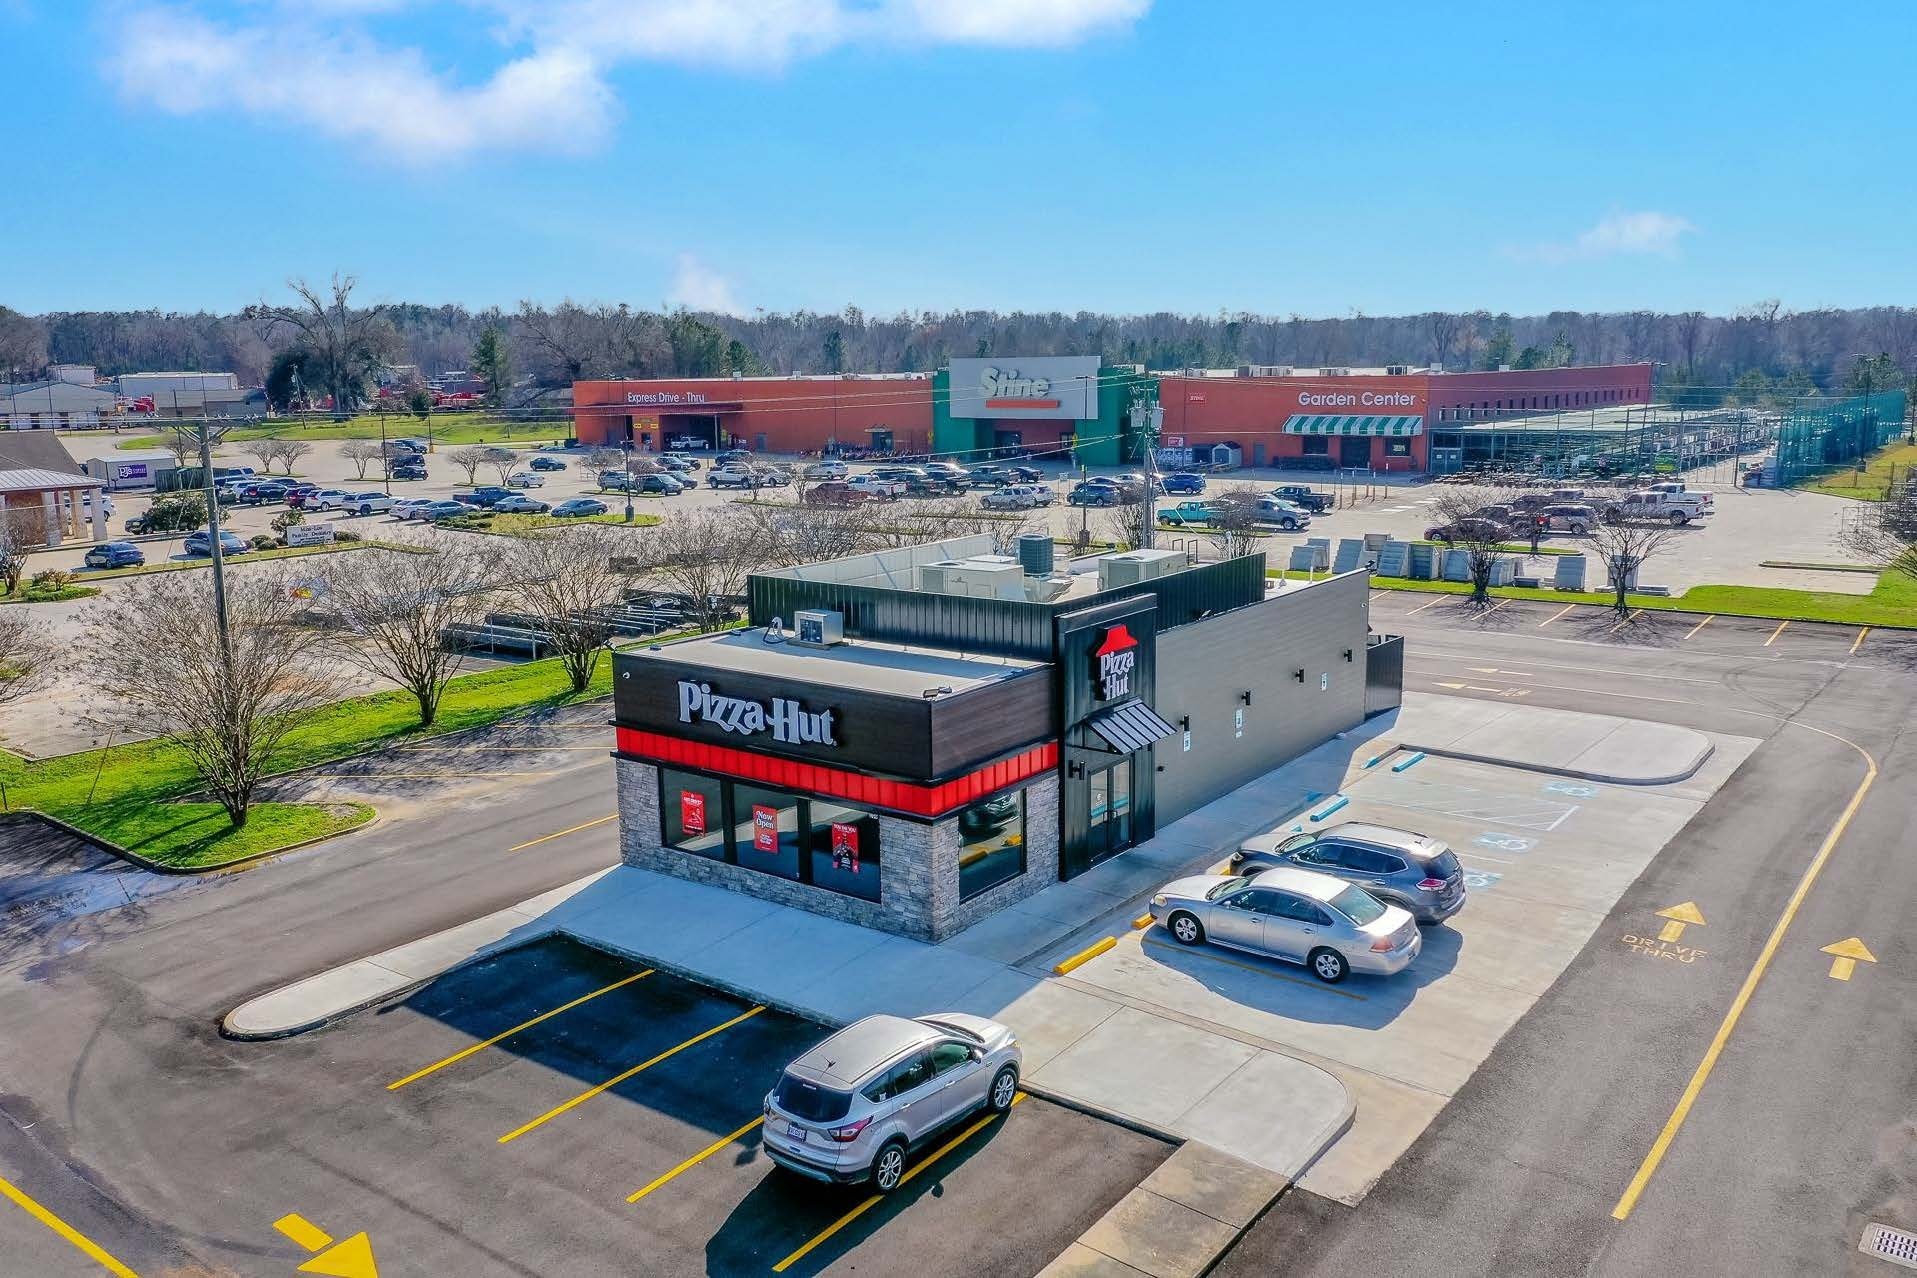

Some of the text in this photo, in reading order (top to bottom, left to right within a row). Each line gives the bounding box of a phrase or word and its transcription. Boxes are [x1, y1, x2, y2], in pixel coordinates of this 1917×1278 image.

[983, 367, 1049, 397] Stine
[627, 391, 657, 404] Express
[658, 392, 679, 403] Drive
[686, 391, 705, 404] Thru
[1298, 391, 1416, 406] Garden Center
[1100, 651, 1134, 681] Pizza
[1103, 673, 1129, 701] Hut
[678, 681, 836, 745] Pizza Hut
[754, 810, 773, 821] Now
[756, 818, 774, 829] Open
